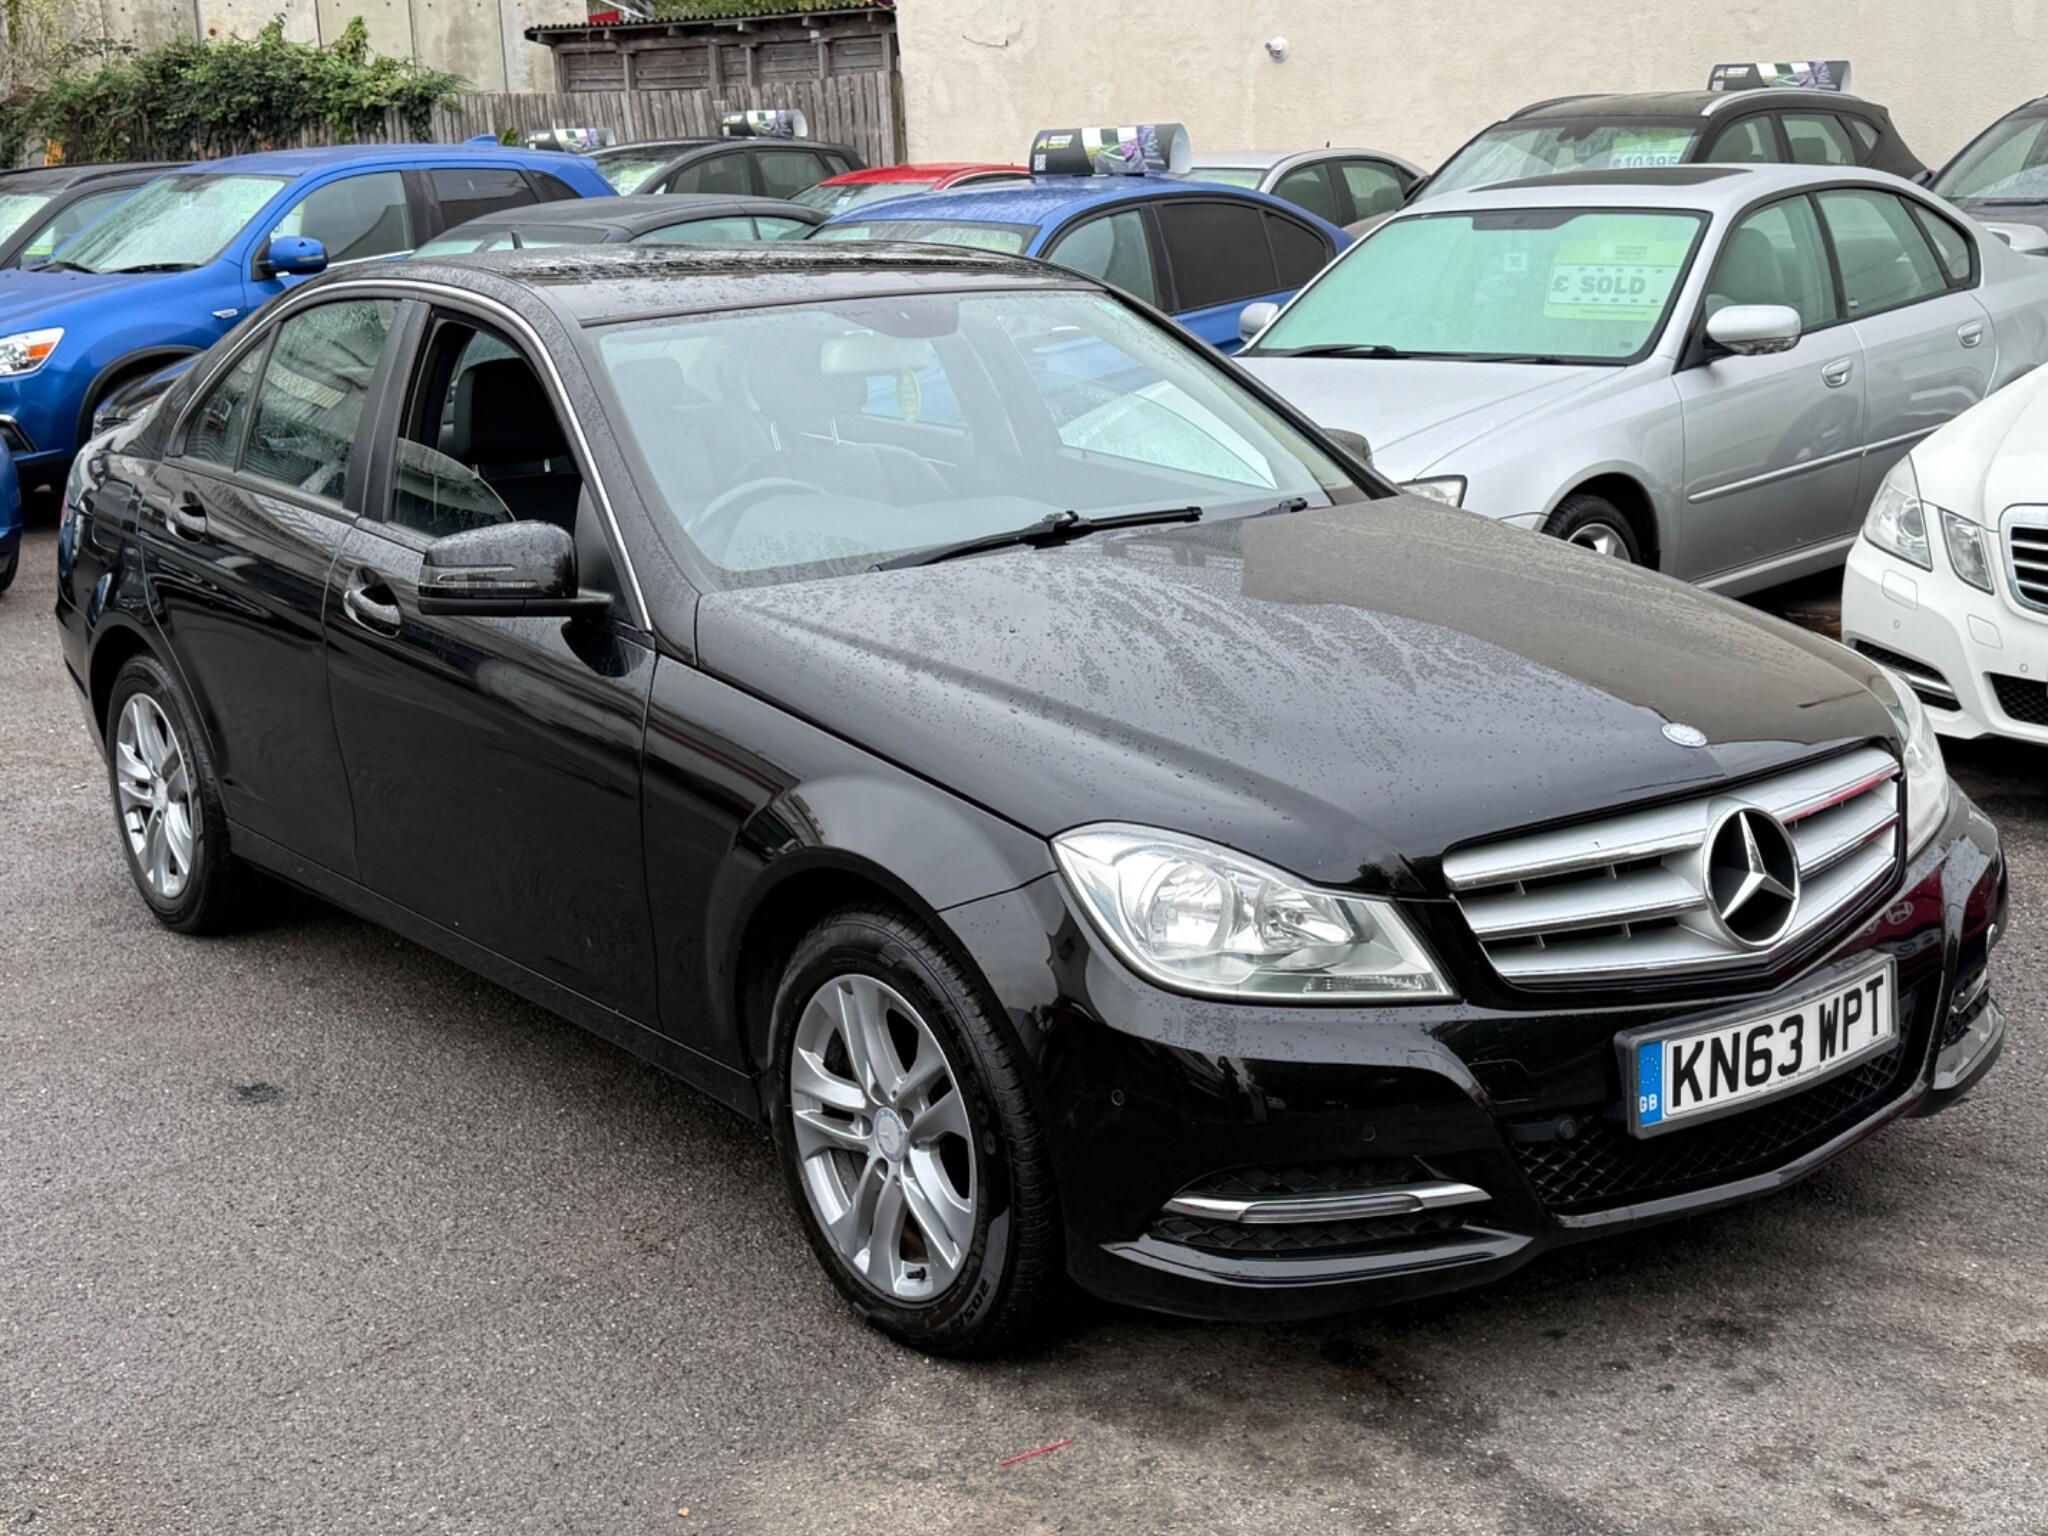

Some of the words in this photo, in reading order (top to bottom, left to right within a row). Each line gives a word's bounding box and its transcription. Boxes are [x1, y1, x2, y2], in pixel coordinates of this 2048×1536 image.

[1551, 275, 1569, 292] £
[1579, 275, 1646, 294] SOLD
[1672, 1013, 1804, 1108] KN63
[1818, 974, 1884, 1062] WPT
[1639, 1093, 1658, 1113] GB
